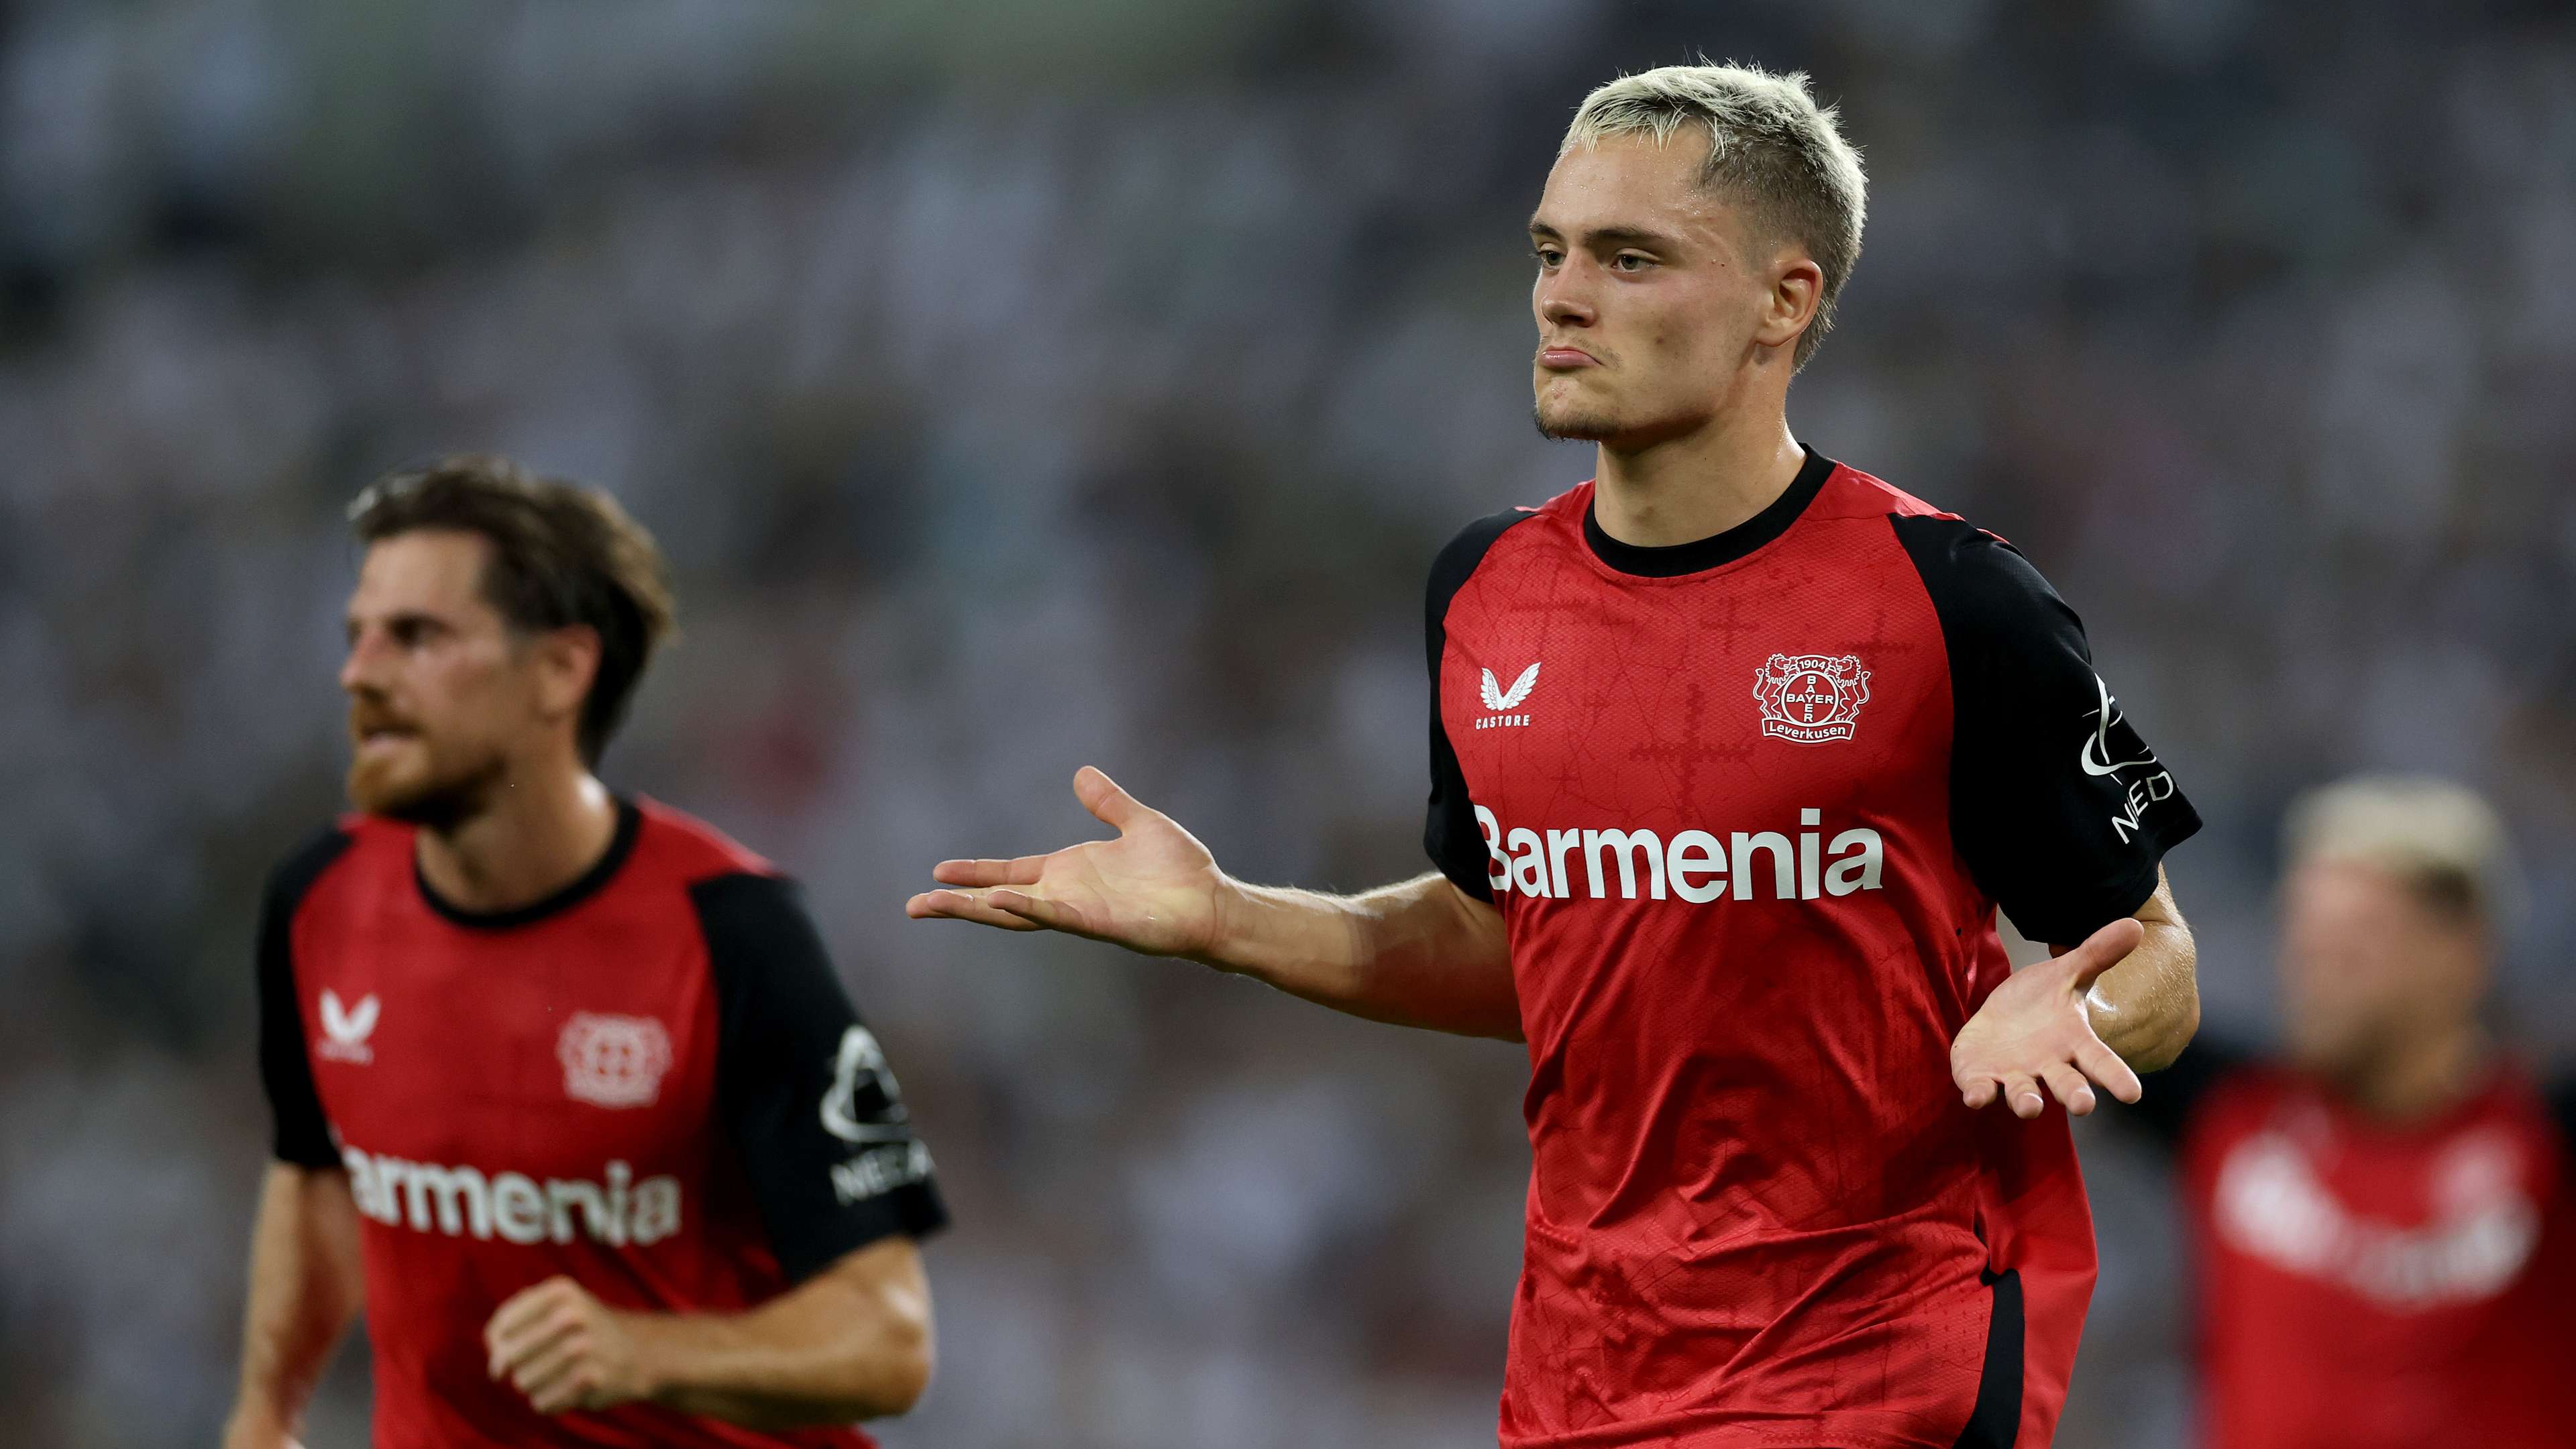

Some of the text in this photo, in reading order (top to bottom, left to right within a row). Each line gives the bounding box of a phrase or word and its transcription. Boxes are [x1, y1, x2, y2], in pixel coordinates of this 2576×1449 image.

[1799, 659, 1826, 670] 1904
[1786, 693, 1834, 704] BAYER
[1803, 676, 1817, 722] BAYER
[1475, 714, 1530, 730] CASTORE
[1769, 721, 1845, 739] Leverkusen
[2111, 770, 2179, 845] NIED
[331, 1123, 682, 1248] armenia
